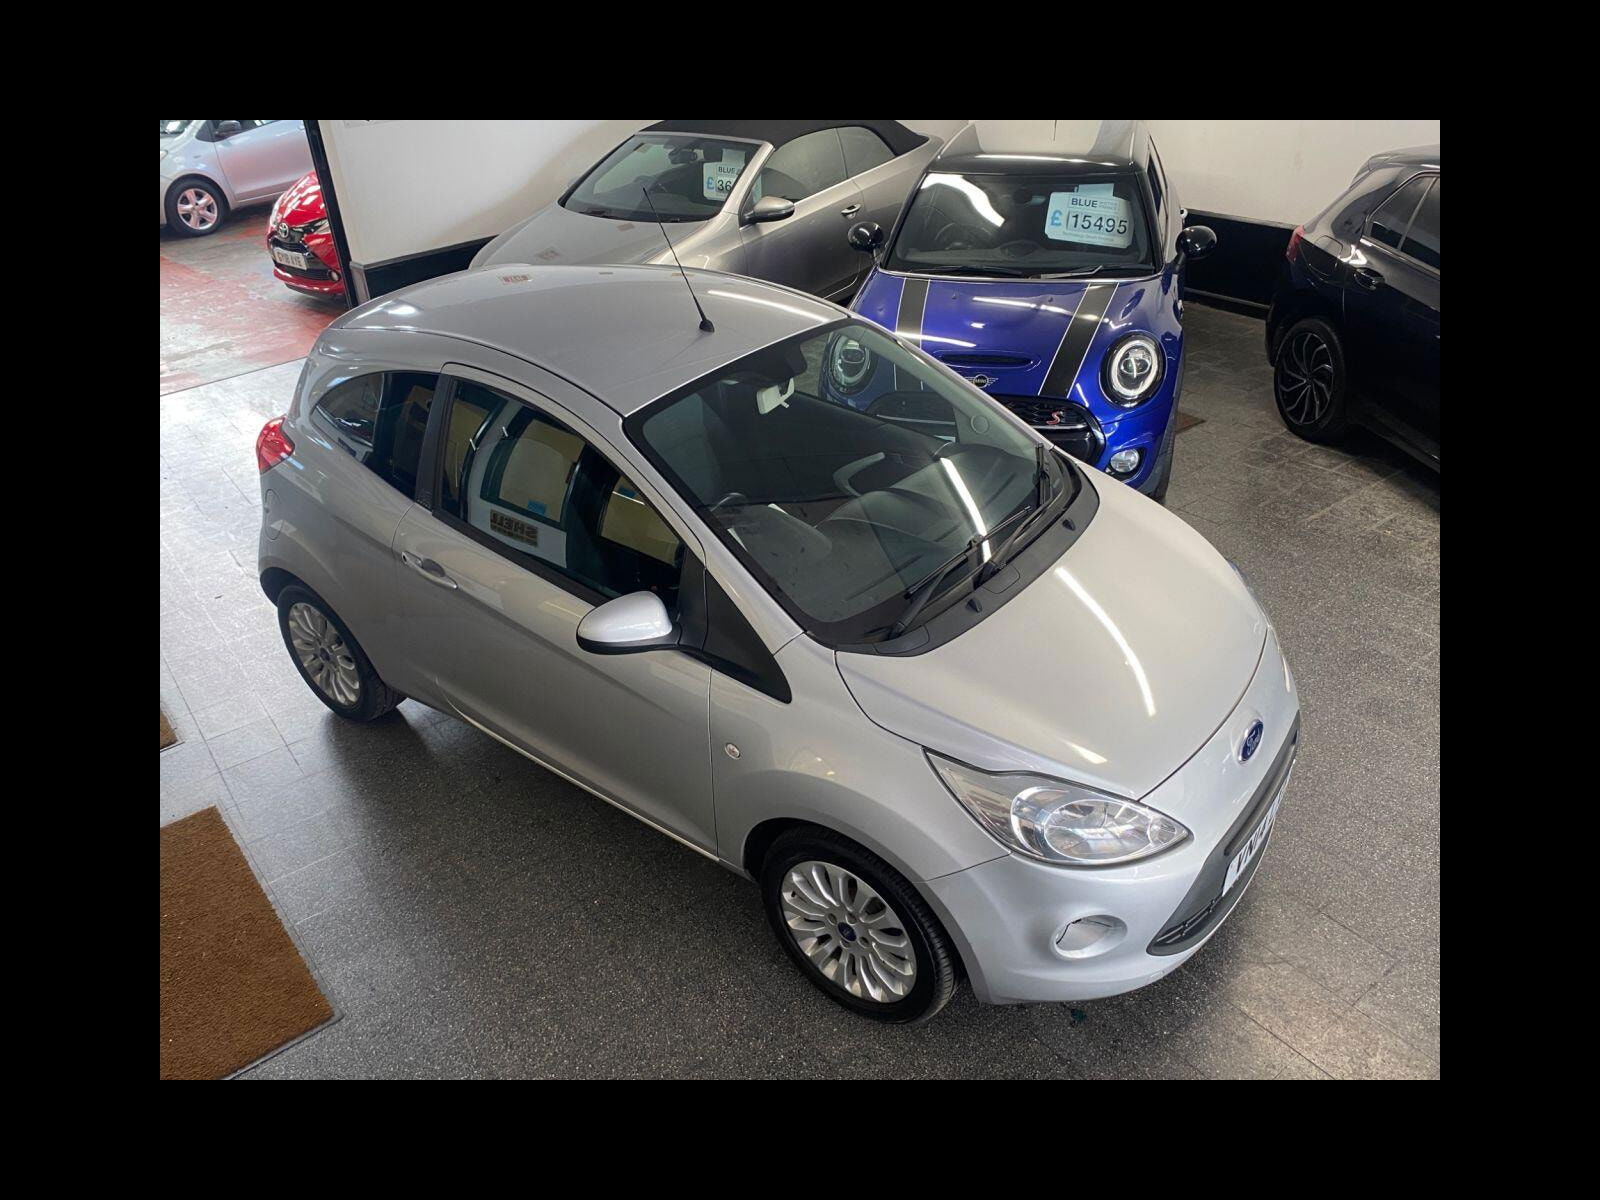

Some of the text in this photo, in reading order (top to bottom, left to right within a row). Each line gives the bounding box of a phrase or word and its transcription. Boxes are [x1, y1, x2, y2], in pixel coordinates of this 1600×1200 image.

[718, 166, 735, 174] BLUE
[1071, 198, 1098, 208] BLUE
[1071, 213, 1128, 235] 15495
